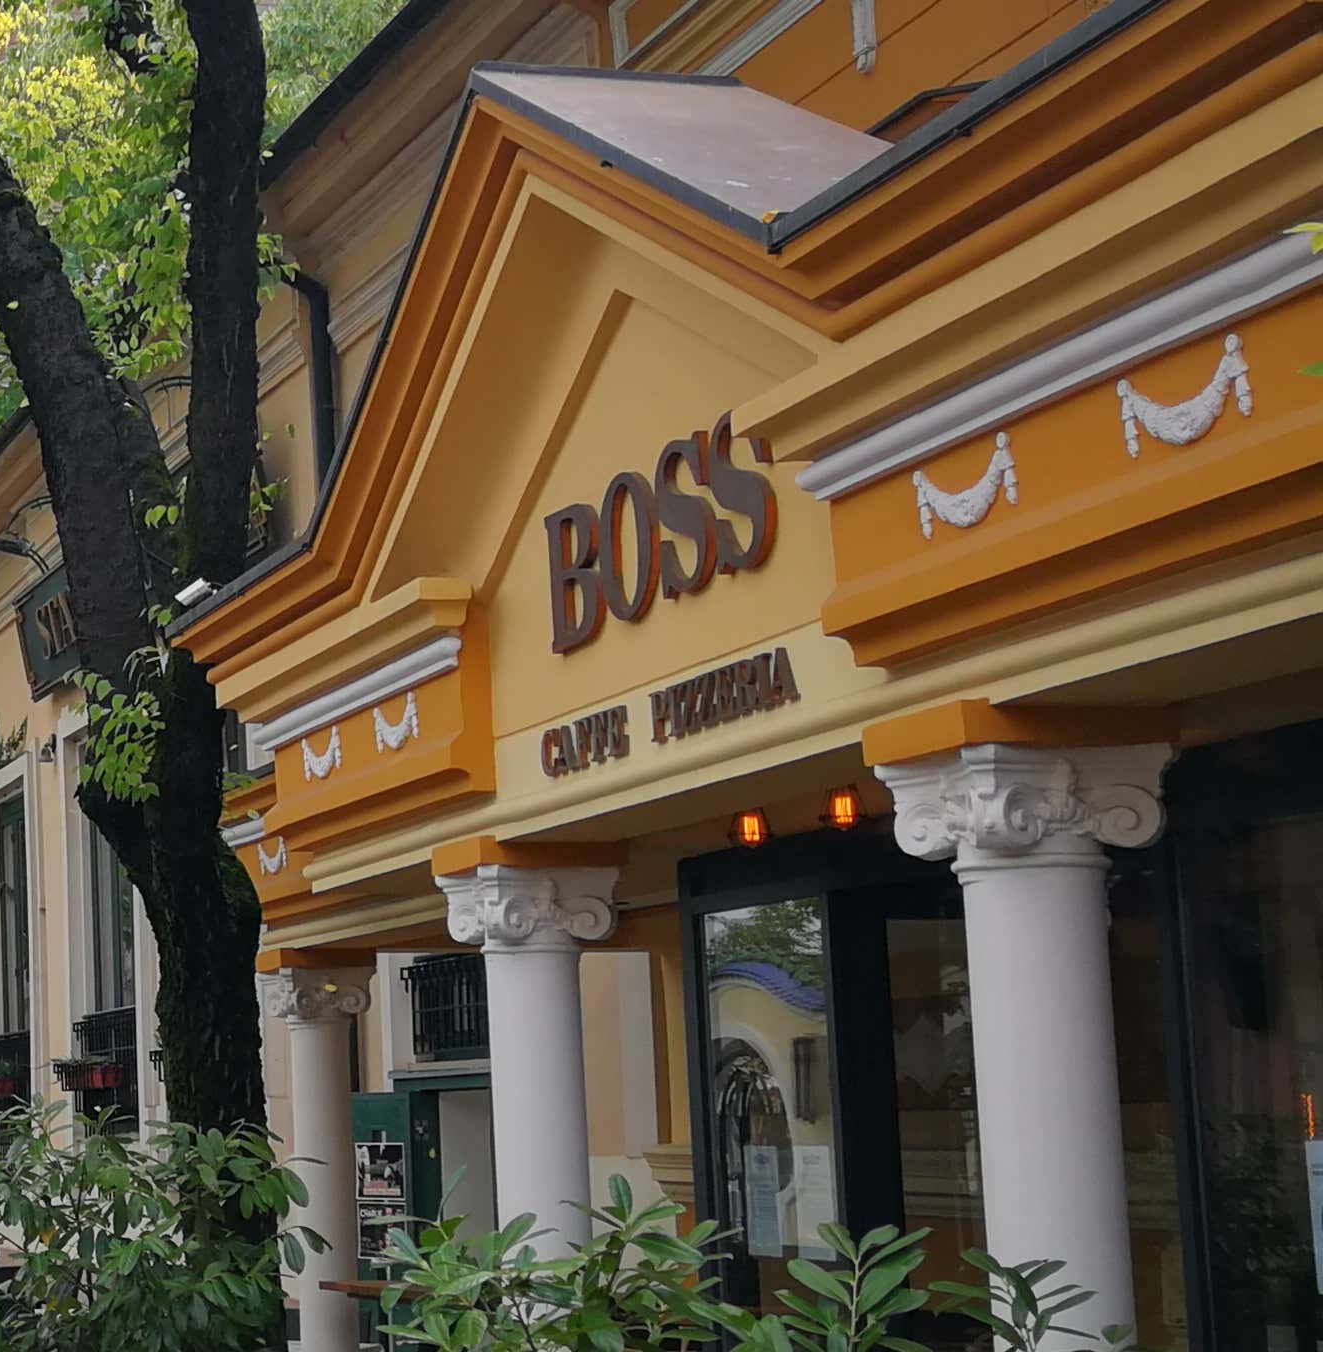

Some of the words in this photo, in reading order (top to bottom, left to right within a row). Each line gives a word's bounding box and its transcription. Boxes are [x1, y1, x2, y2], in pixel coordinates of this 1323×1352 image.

[544, 410, 778, 654] BOSS
[540, 704, 631, 778] CAFFE
[648, 647, 802, 744] PIZZERIA
